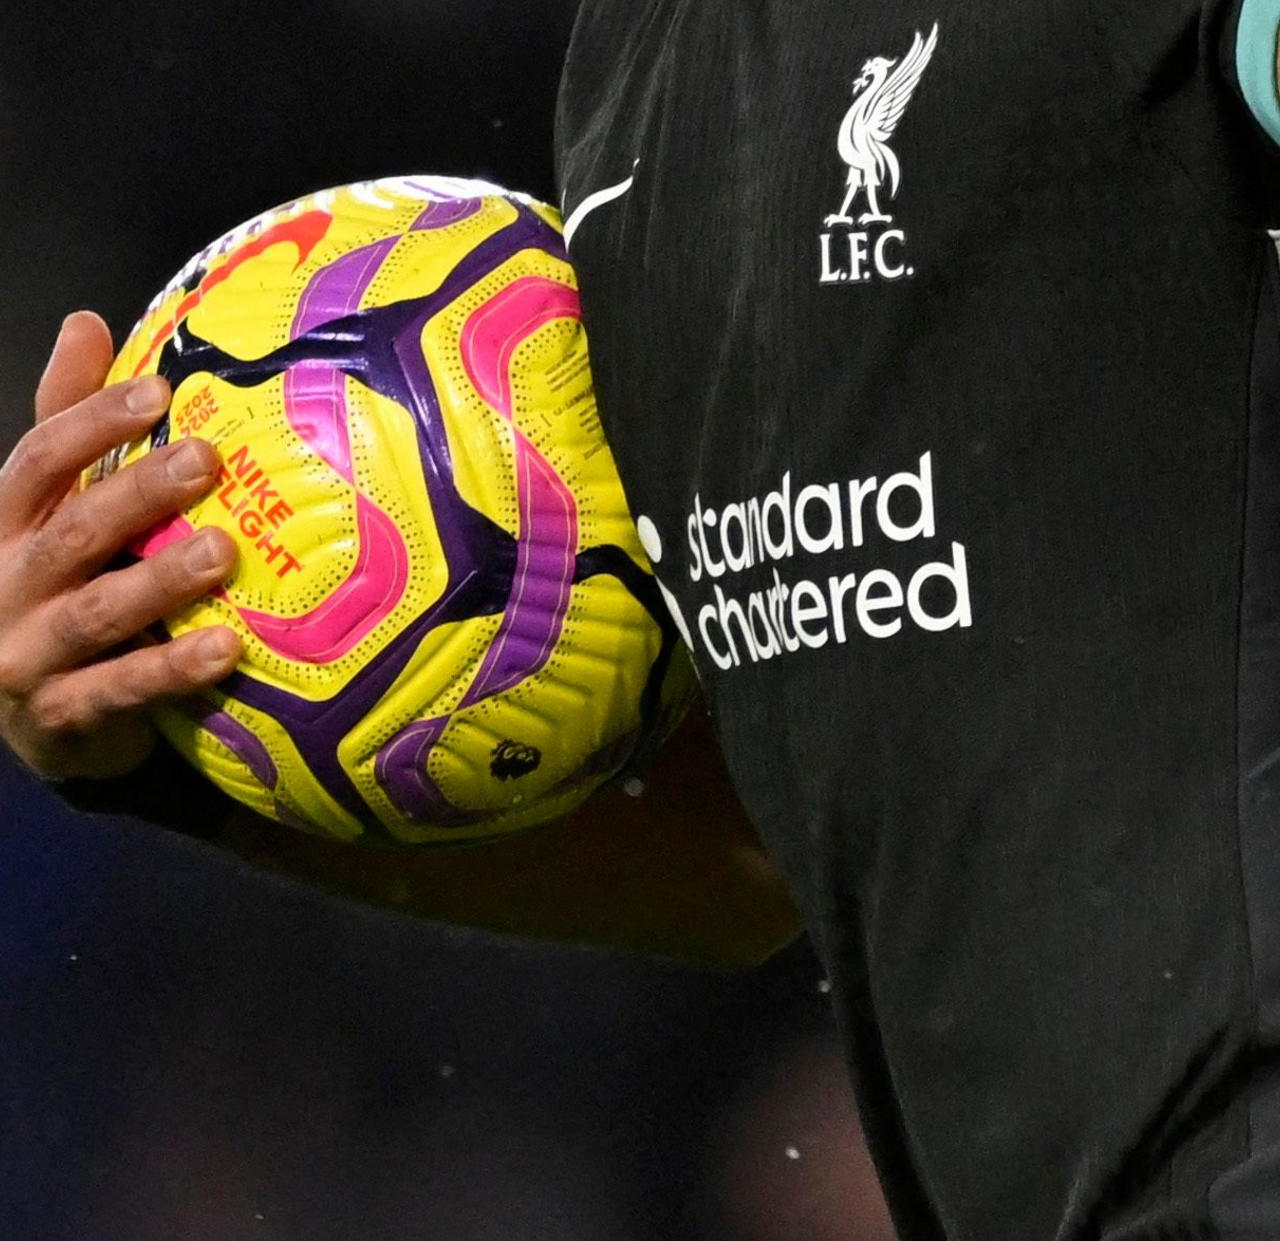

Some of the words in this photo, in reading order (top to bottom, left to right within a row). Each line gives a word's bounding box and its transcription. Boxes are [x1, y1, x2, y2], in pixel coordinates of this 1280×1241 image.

[820, 229, 914, 282] L.F.C.
[226, 444, 295, 530] NIKE
[687, 450, 935, 582] standard
[698, 541, 972, 670] chartered
